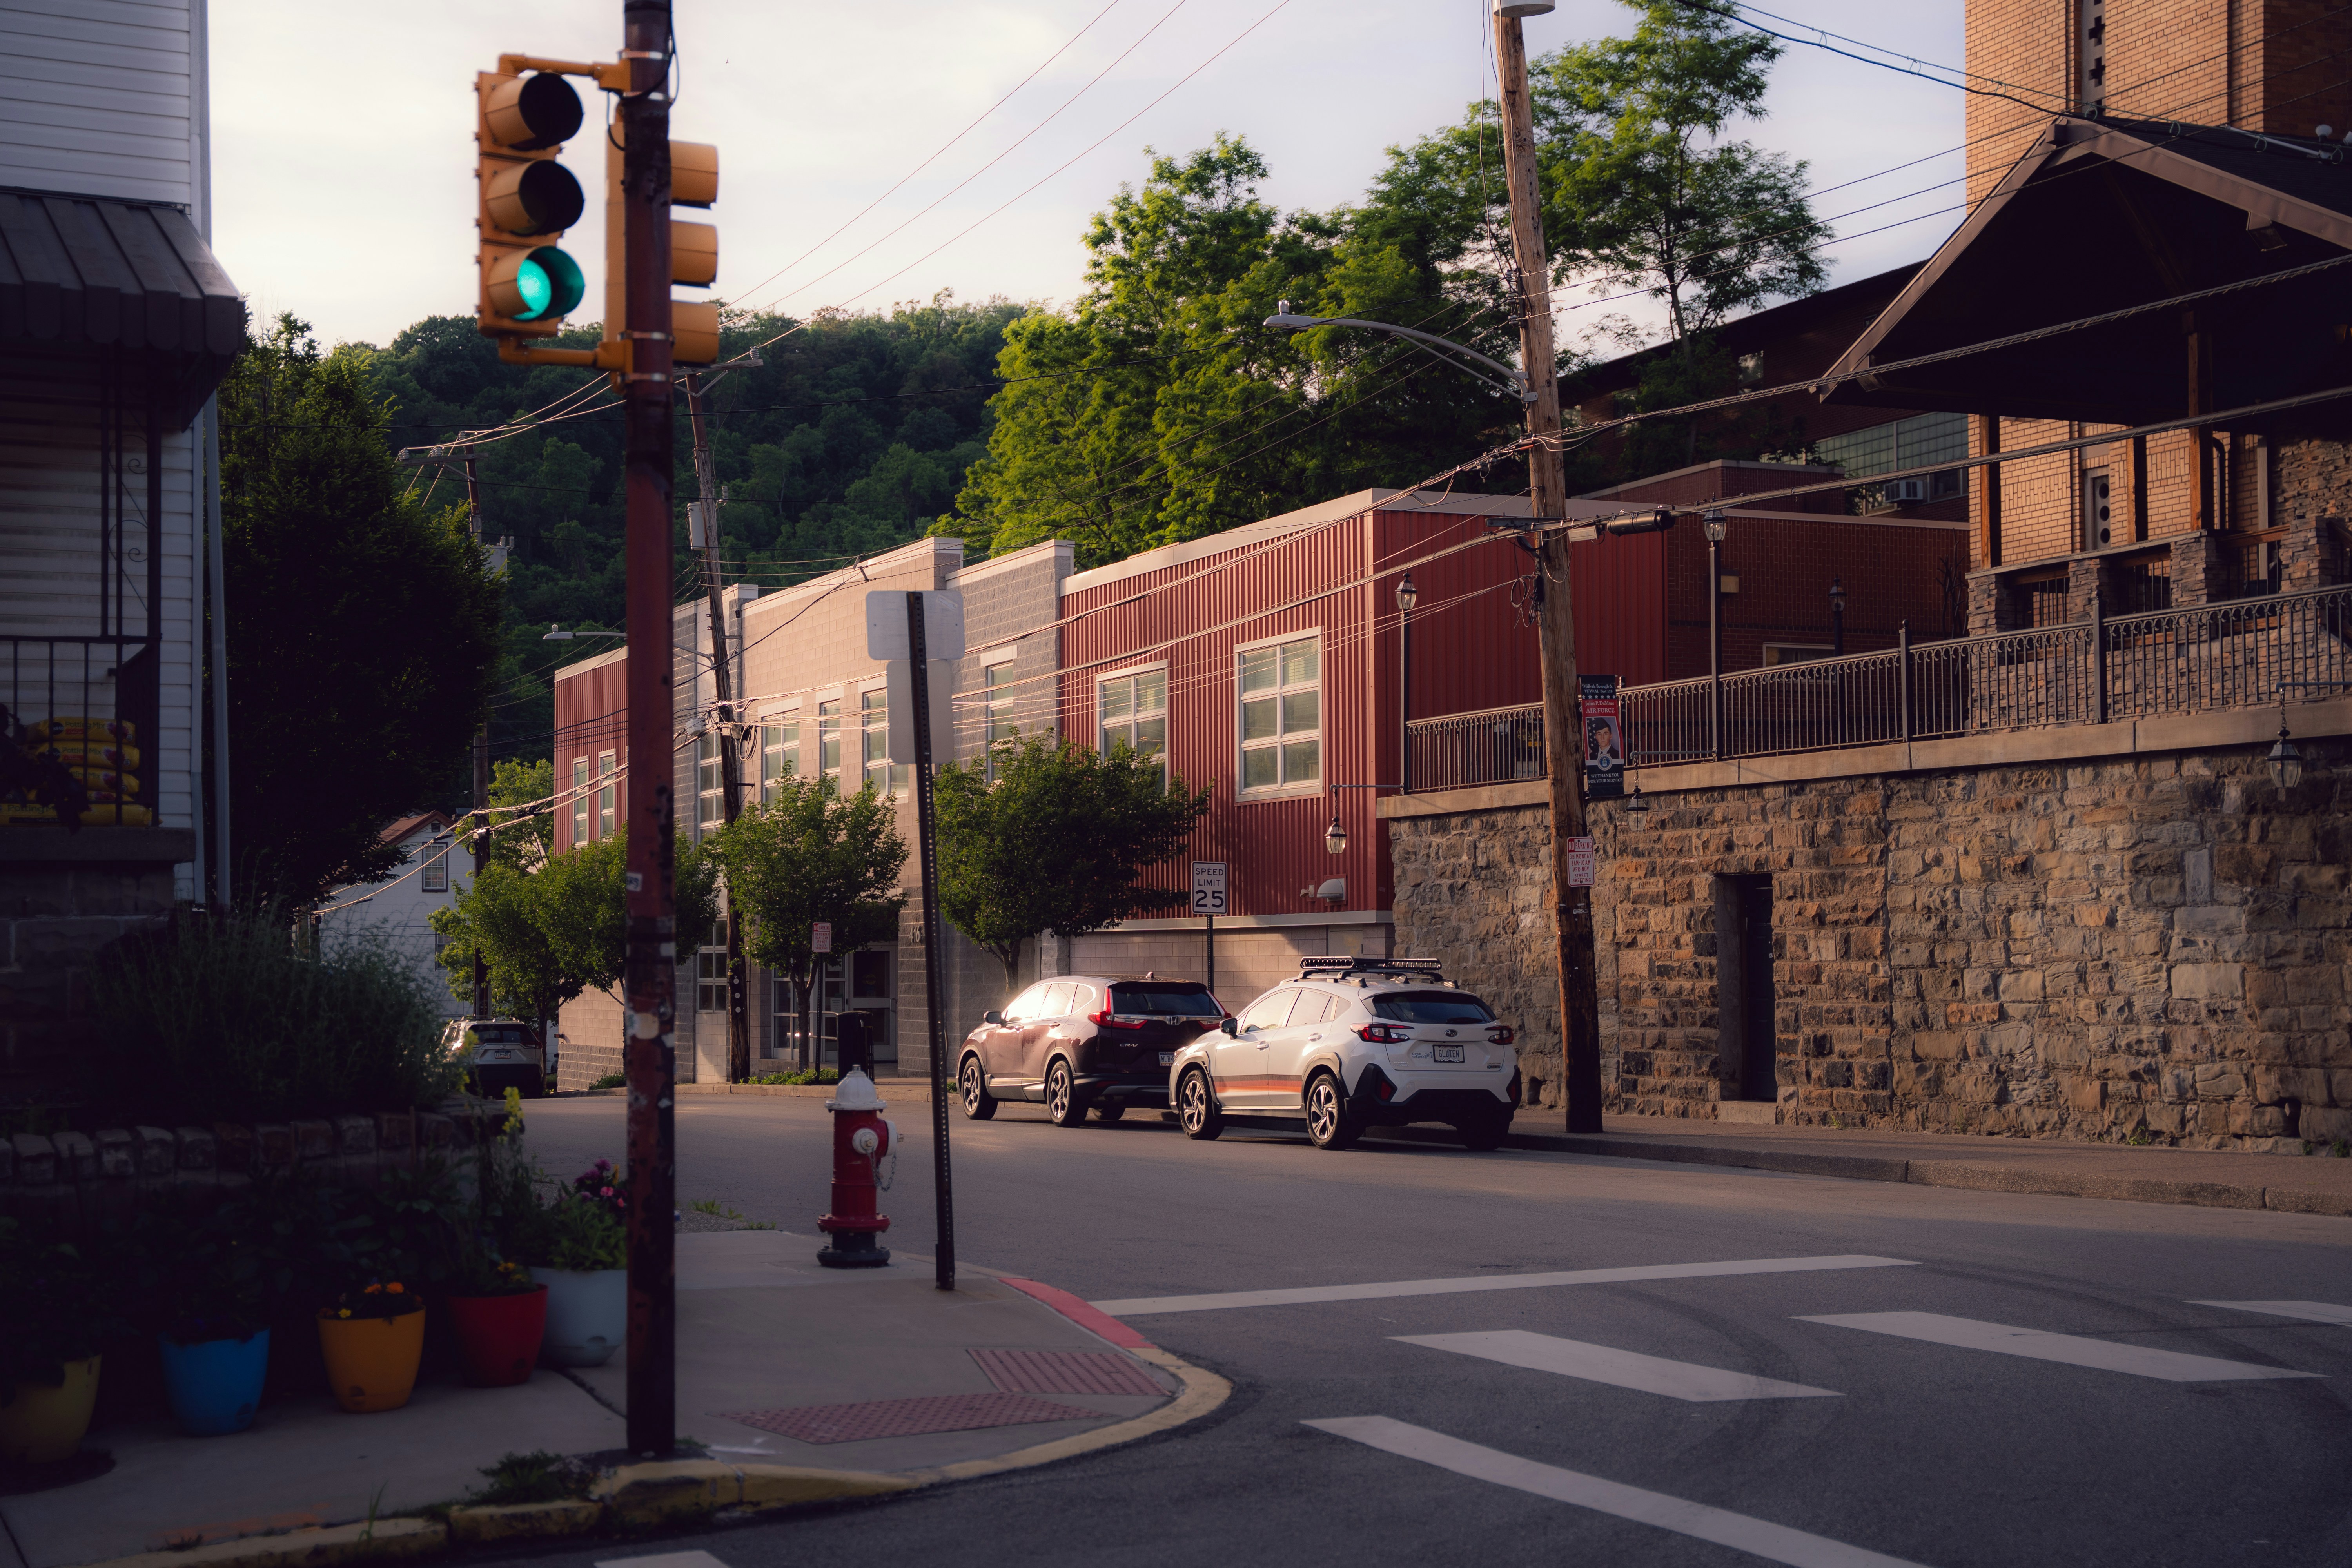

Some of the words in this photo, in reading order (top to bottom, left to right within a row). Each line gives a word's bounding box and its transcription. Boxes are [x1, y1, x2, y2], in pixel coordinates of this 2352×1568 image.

[1569, 841, 1574, 850] NO
[1195, 889, 1224, 908] 25
[909, 925, 920, 943] 416
[1439, 1049, 1459, 1058] GLUTEN
